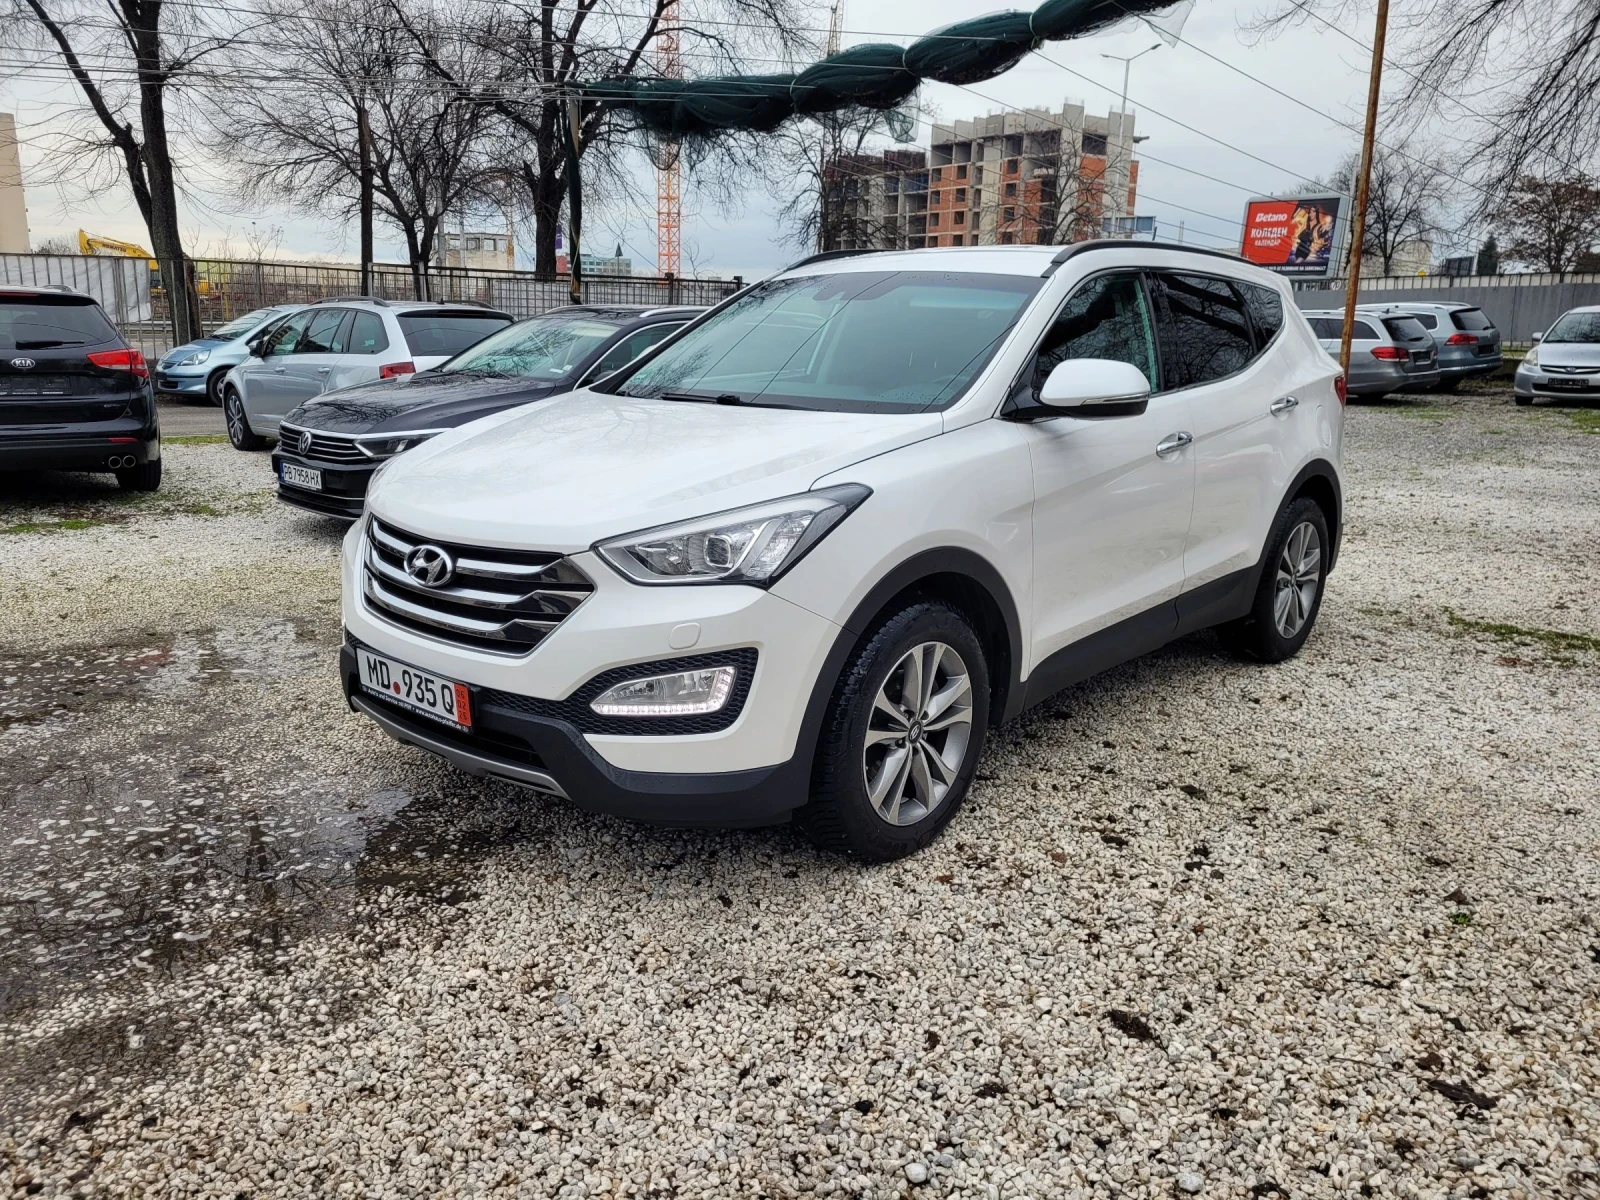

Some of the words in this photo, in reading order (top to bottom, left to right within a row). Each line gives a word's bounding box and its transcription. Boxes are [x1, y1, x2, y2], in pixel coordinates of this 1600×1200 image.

[1255, 212, 1288, 222] Betano
[1250, 226, 1288, 239] КОЛЕДЕН
[15, 359, 32, 367] KIA
[366, 655, 390, 690] MD
[402, 669, 437, 708] 935
[440, 683, 455, 716] Q
